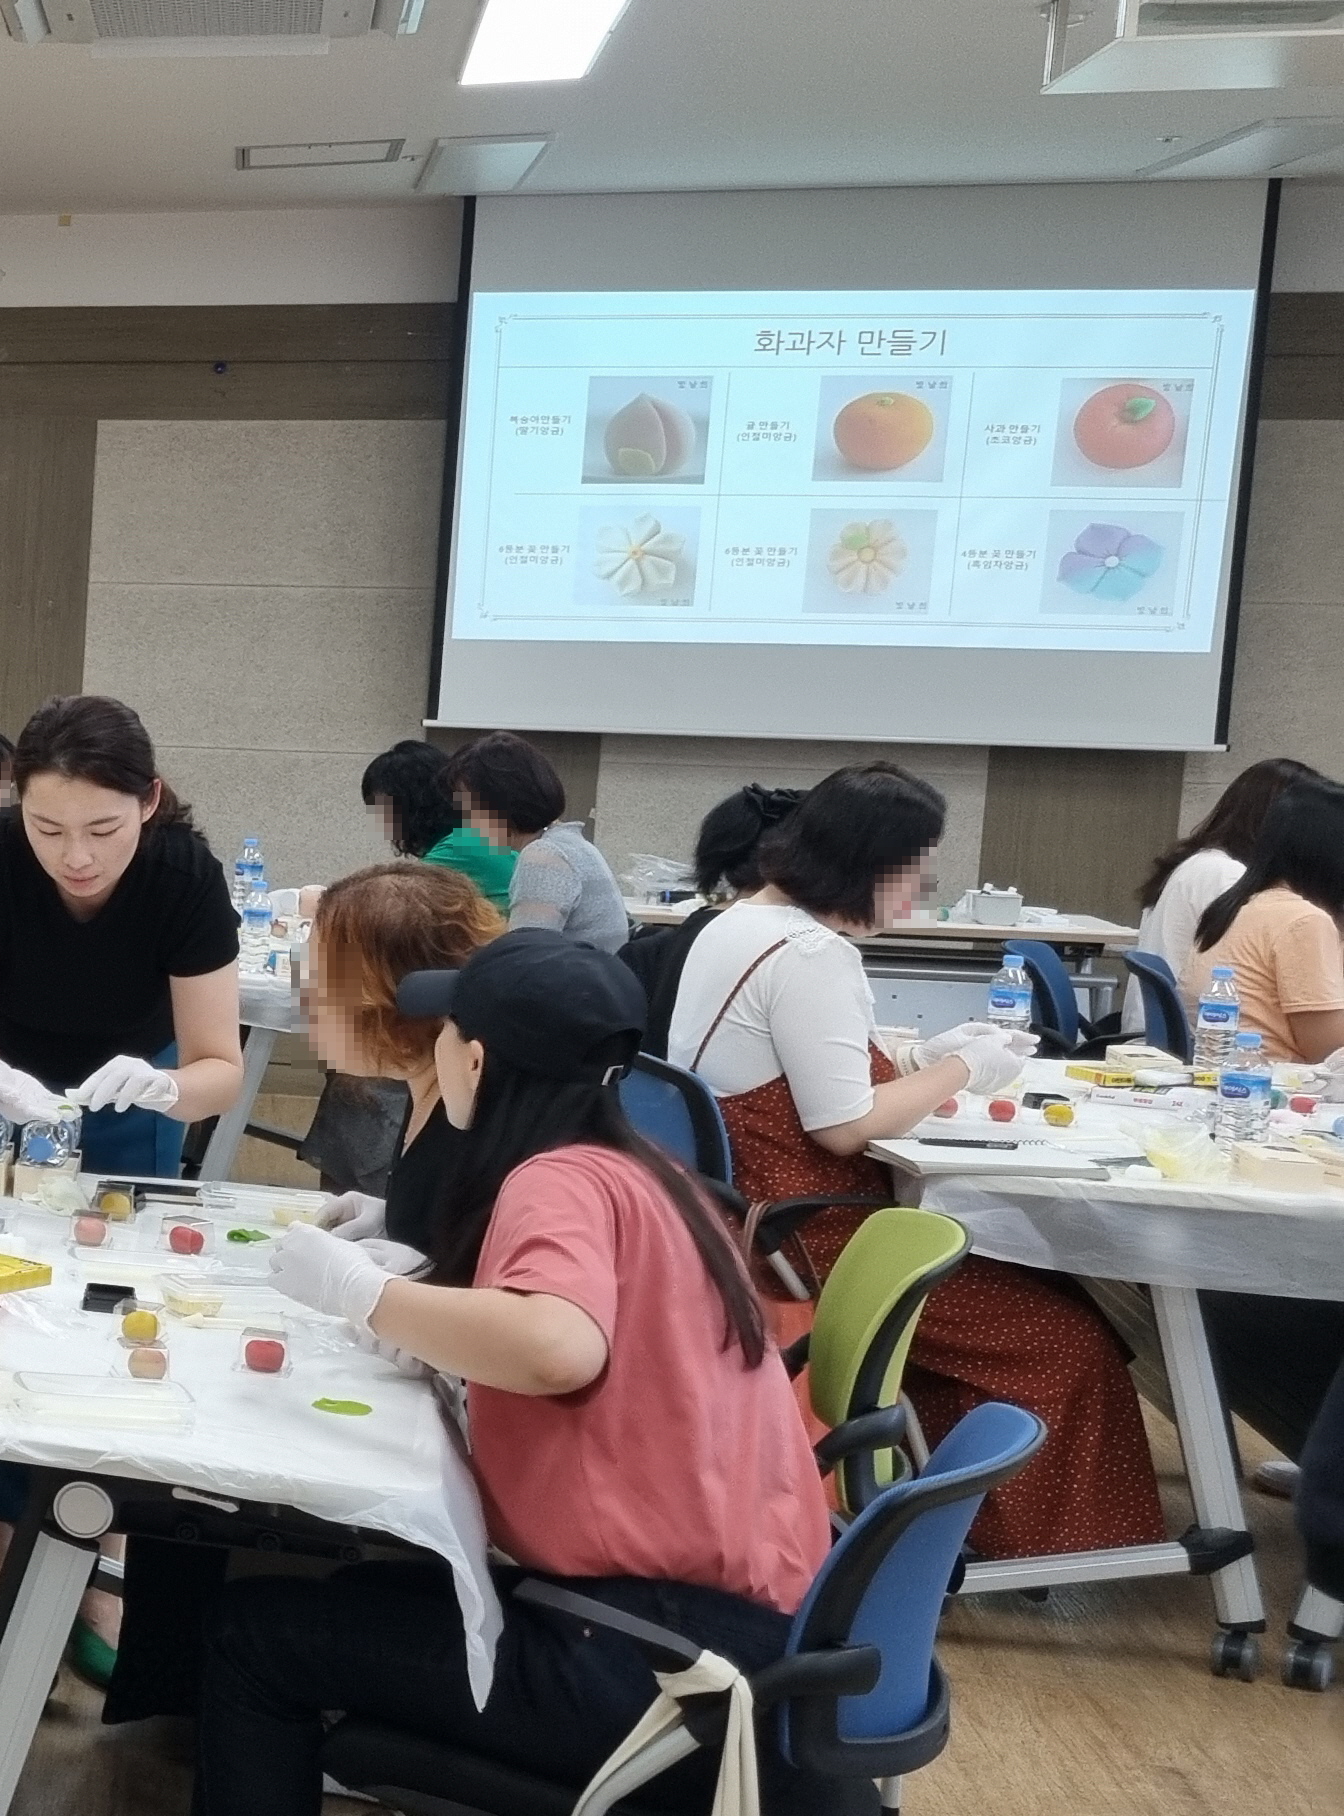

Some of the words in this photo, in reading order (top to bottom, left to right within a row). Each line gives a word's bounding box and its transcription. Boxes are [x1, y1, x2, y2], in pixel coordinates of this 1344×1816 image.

[754, 329, 847, 356] 화과자
[857, 329, 947, 356] 만들기
[758, 421, 790, 431] 만들기
[984, 424, 1007, 434] 사과
[1009, 424, 1041, 434] 만들기
